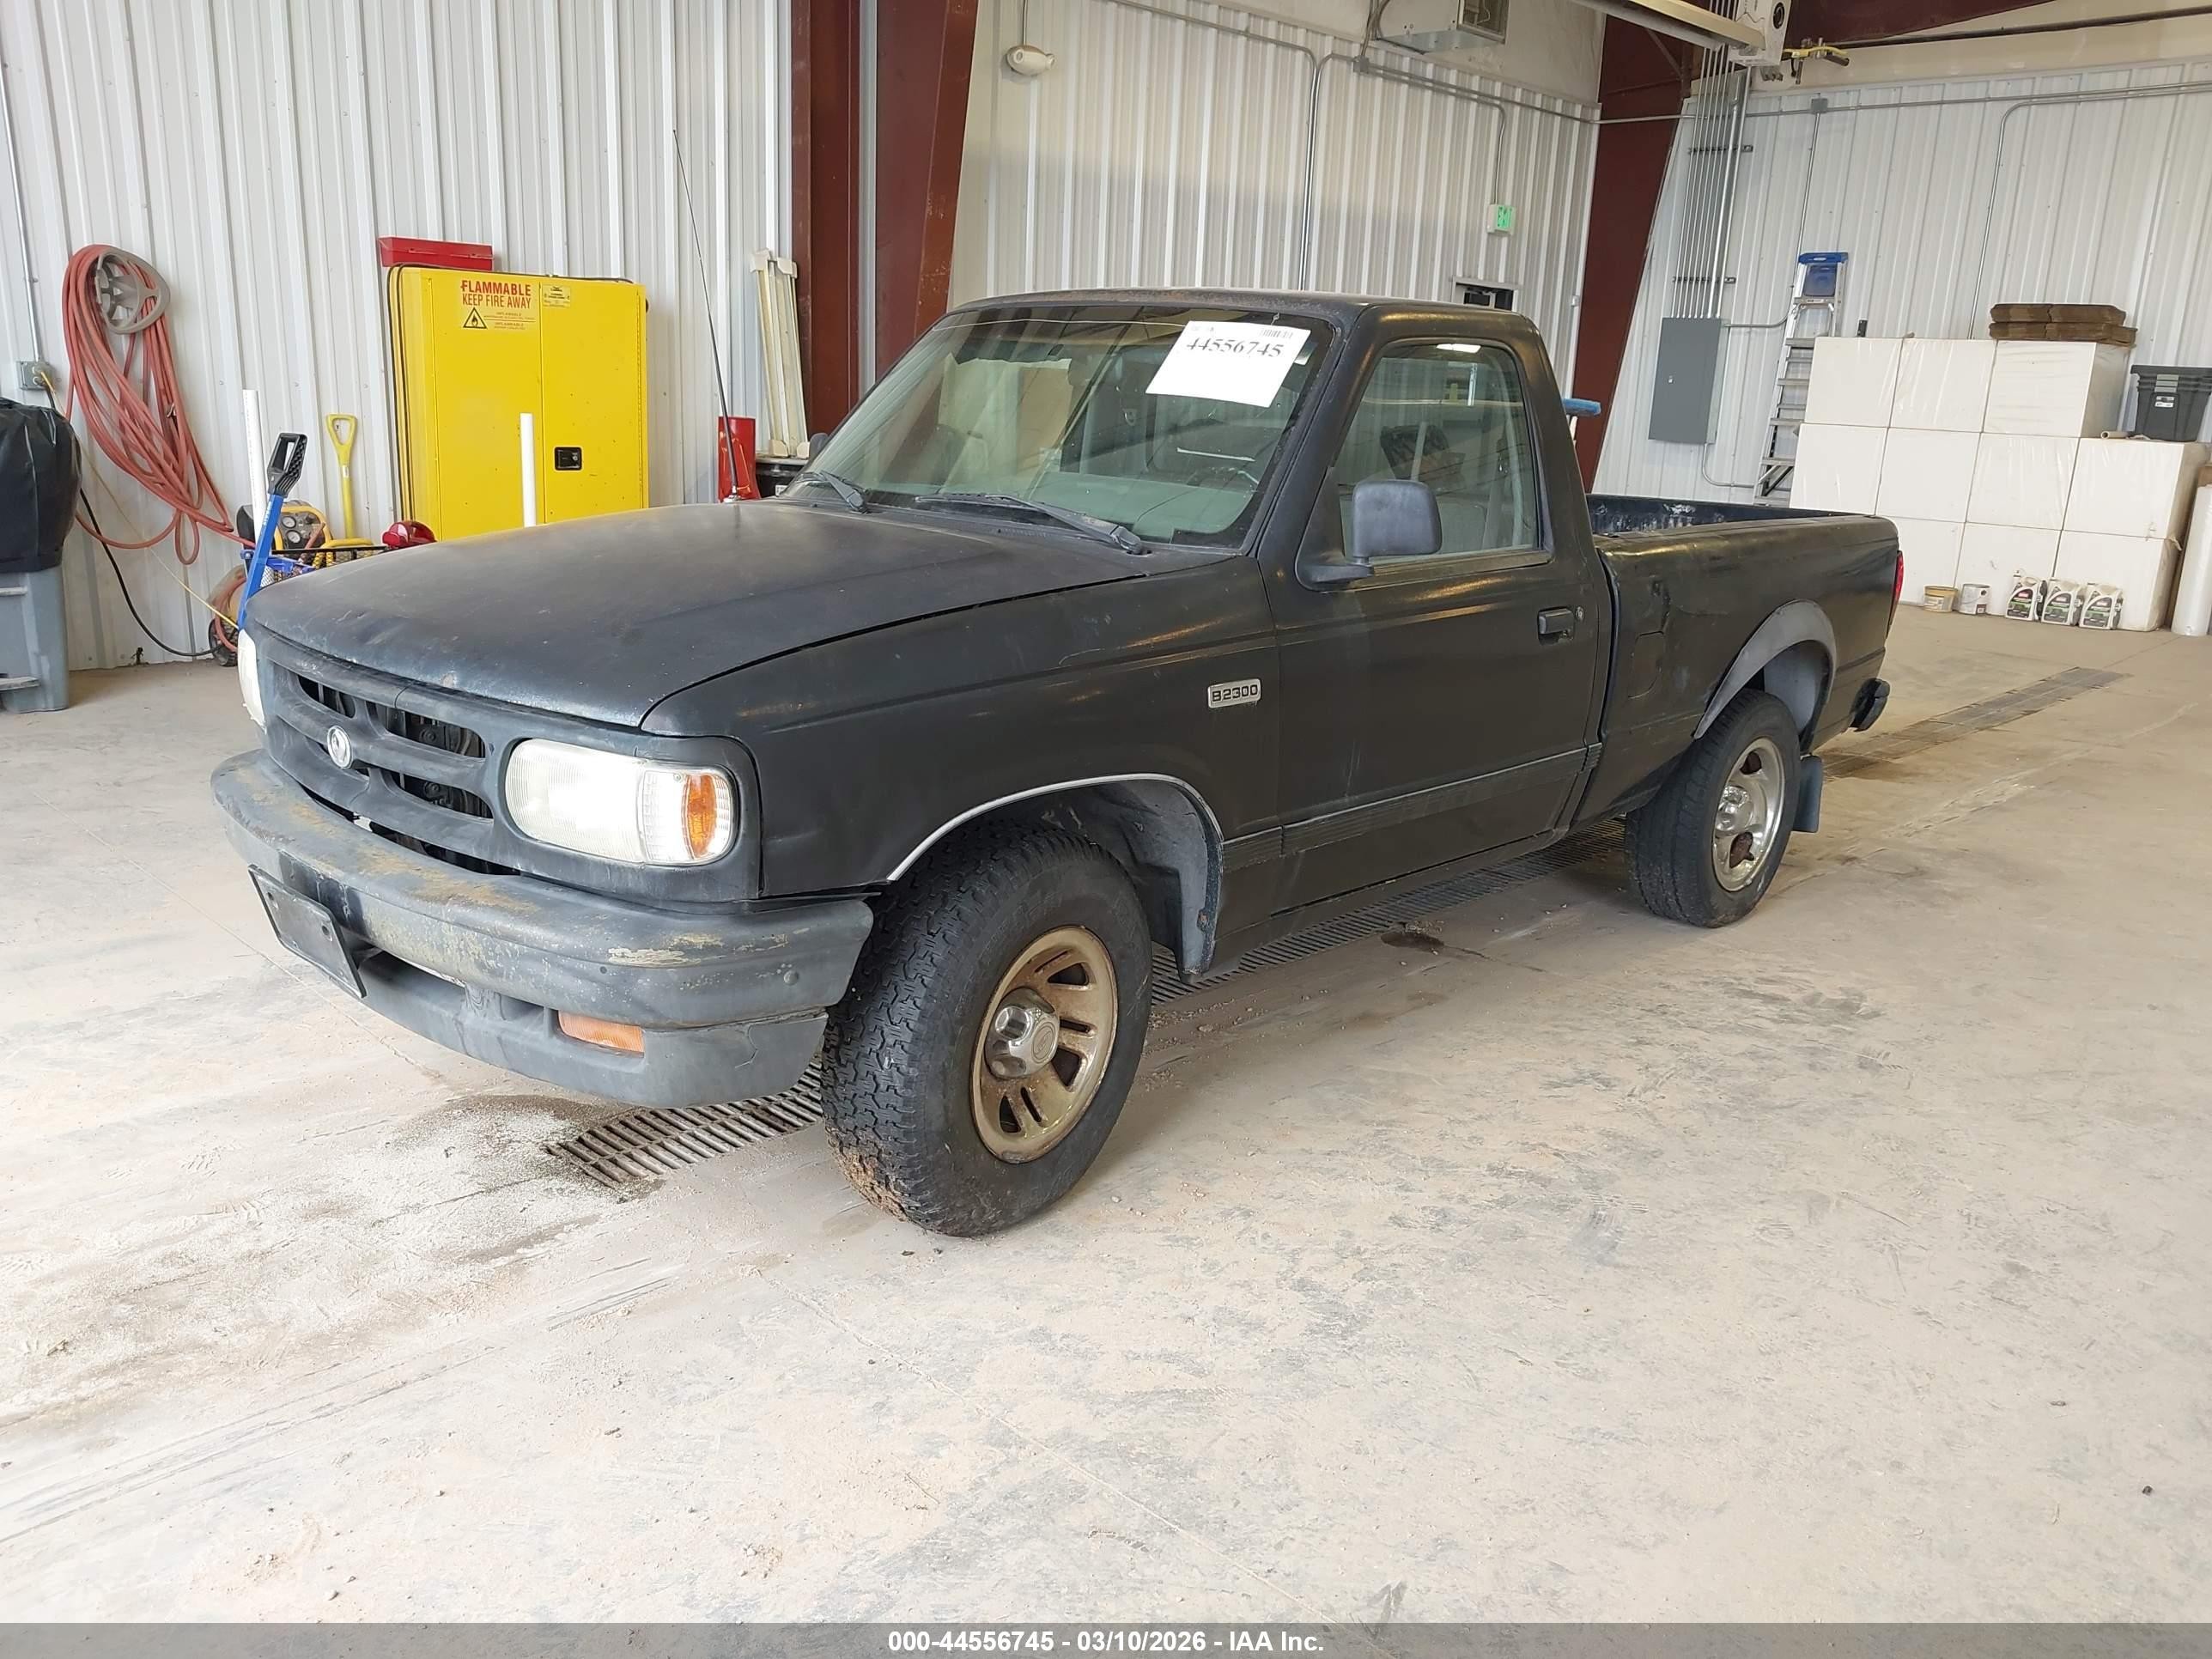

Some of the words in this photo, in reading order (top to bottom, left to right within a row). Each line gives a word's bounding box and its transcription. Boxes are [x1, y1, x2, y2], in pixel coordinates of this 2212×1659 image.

[461, 280, 531, 296] FLAMMABLE
[462, 293, 483, 307] KEEP
[486, 295, 505, 307] FIRE
[507, 296, 532, 309] AWAY
[1186, 337, 1285, 357] 44556745
[1212, 684, 1258, 702] B2300
